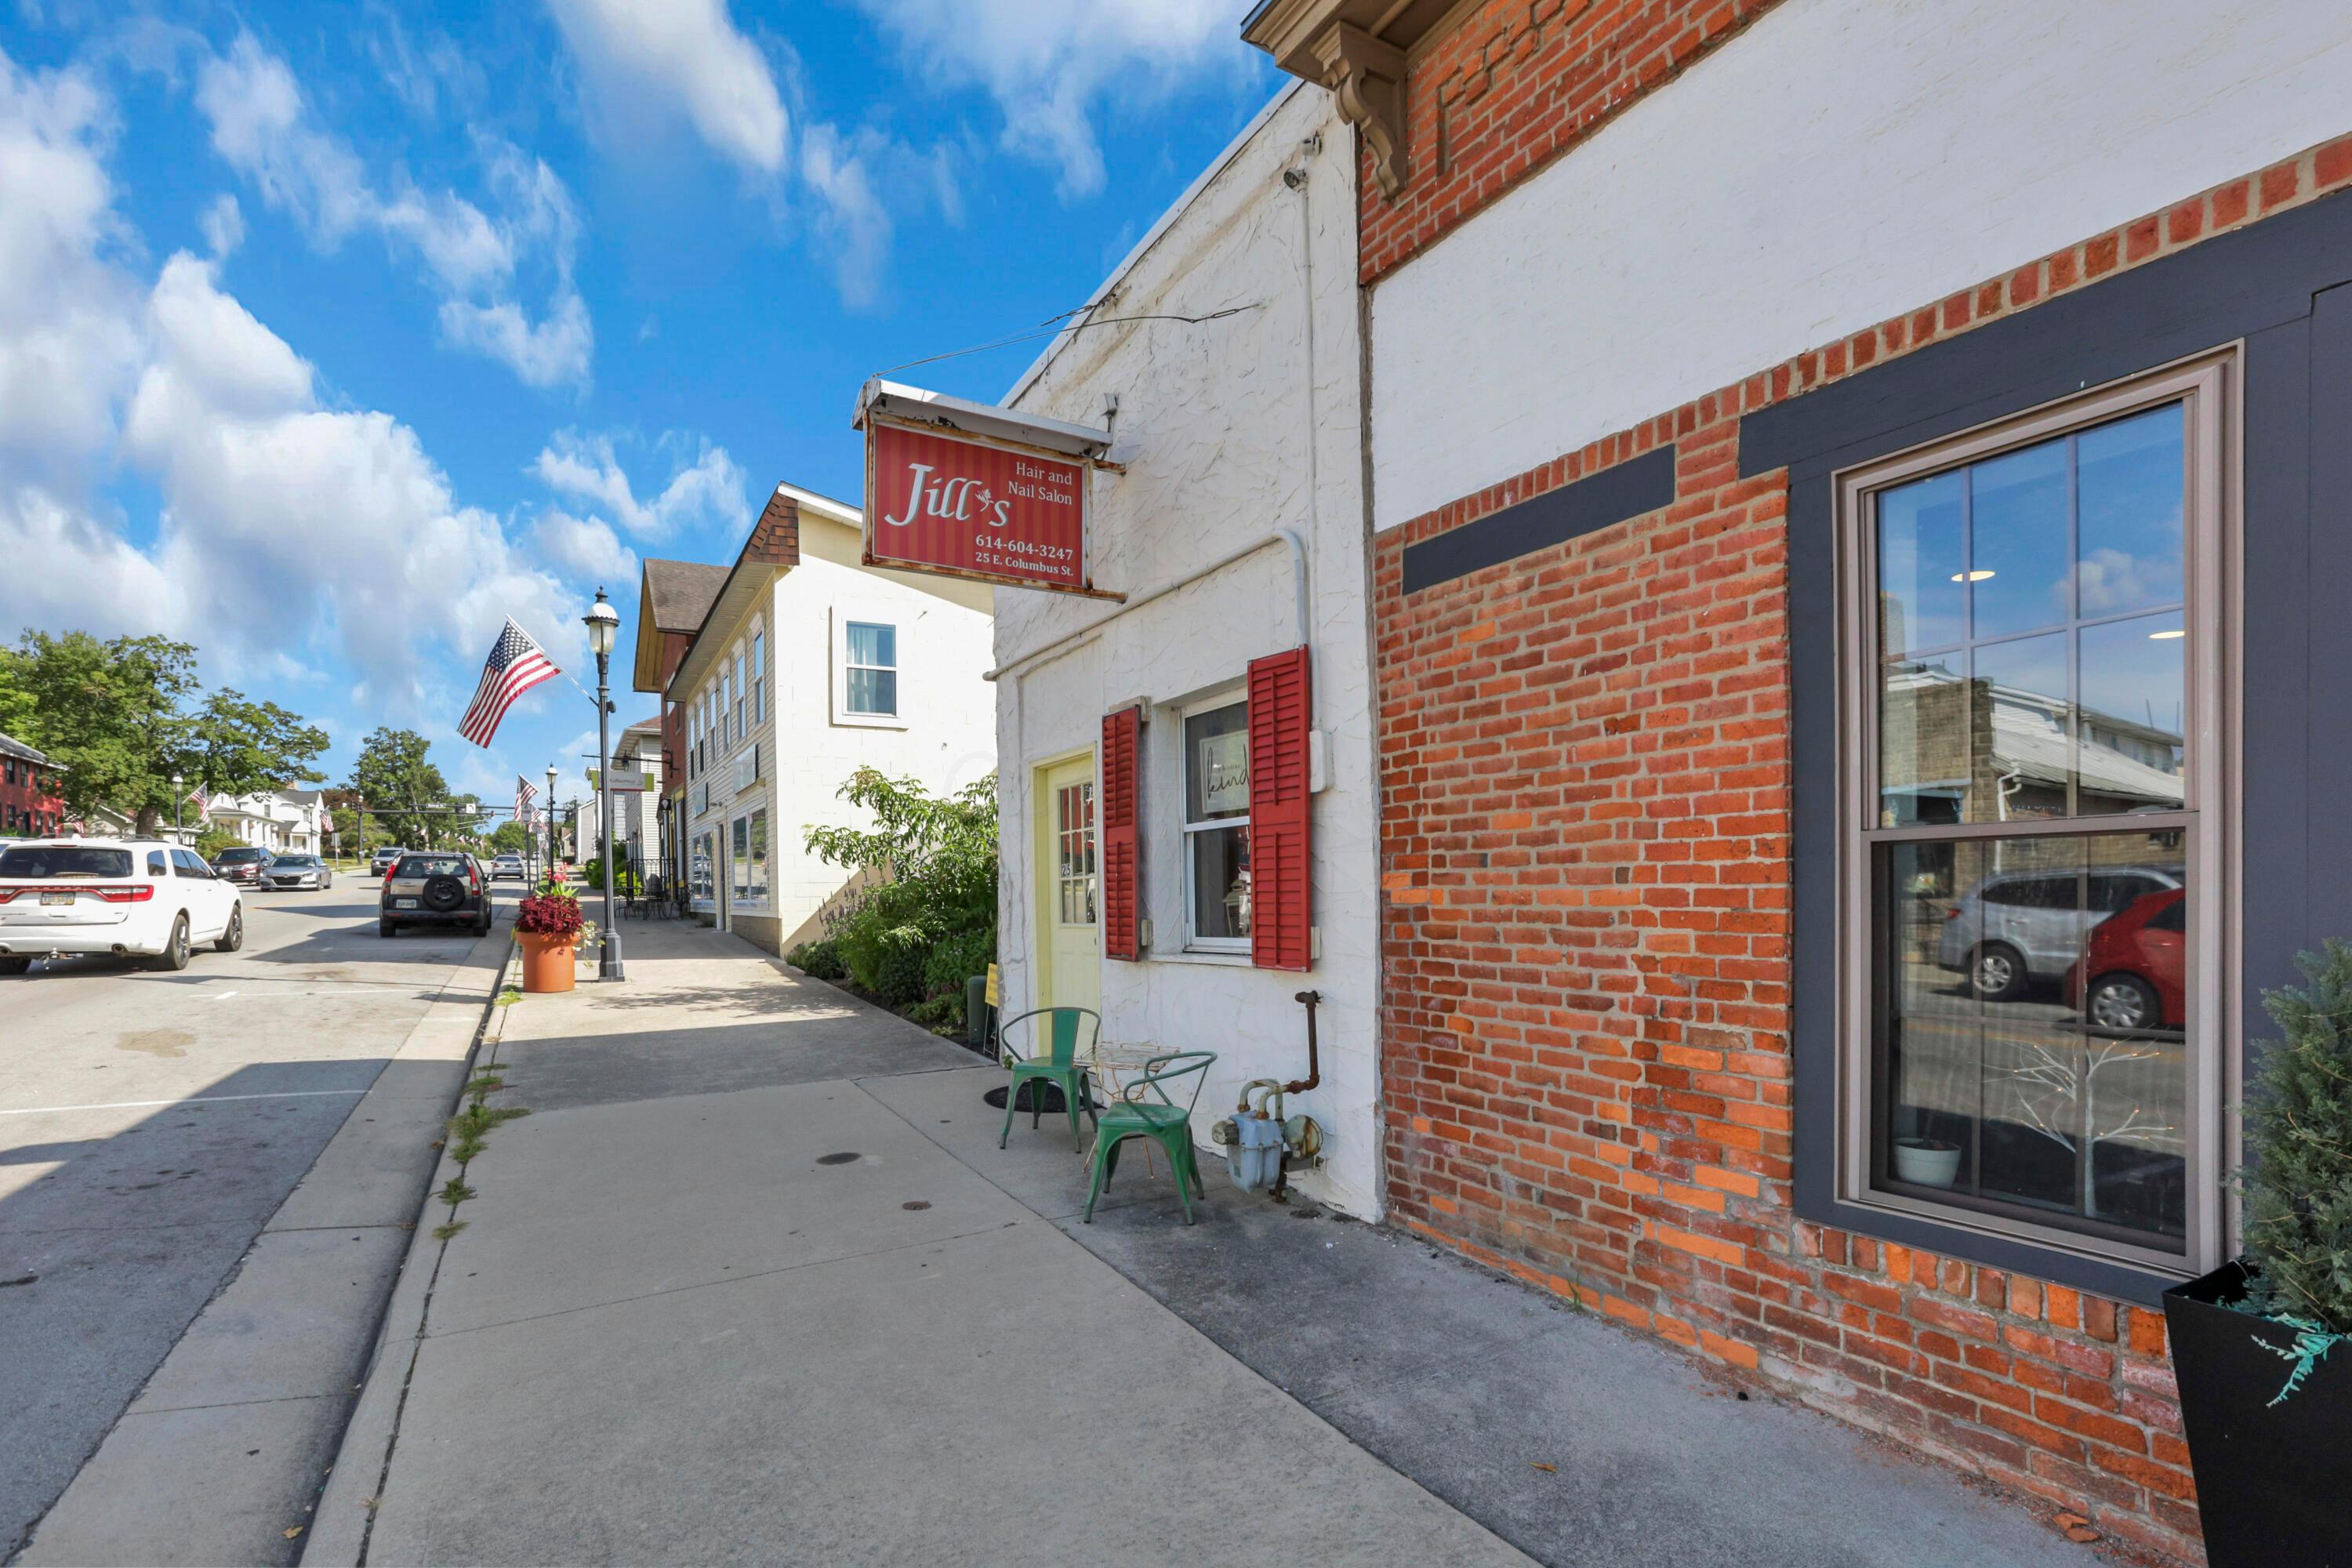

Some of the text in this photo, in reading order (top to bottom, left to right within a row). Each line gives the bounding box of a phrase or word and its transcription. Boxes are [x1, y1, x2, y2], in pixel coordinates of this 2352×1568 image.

[1016, 462, 1073, 485] Hair and
[884, 463, 1011, 527] Jill's
[1008, 481, 1073, 506] Nail Salon
[975, 534, 1073, 561] 614-604-3247
[975, 551, 1074, 576] 25 E. Columbus St.
